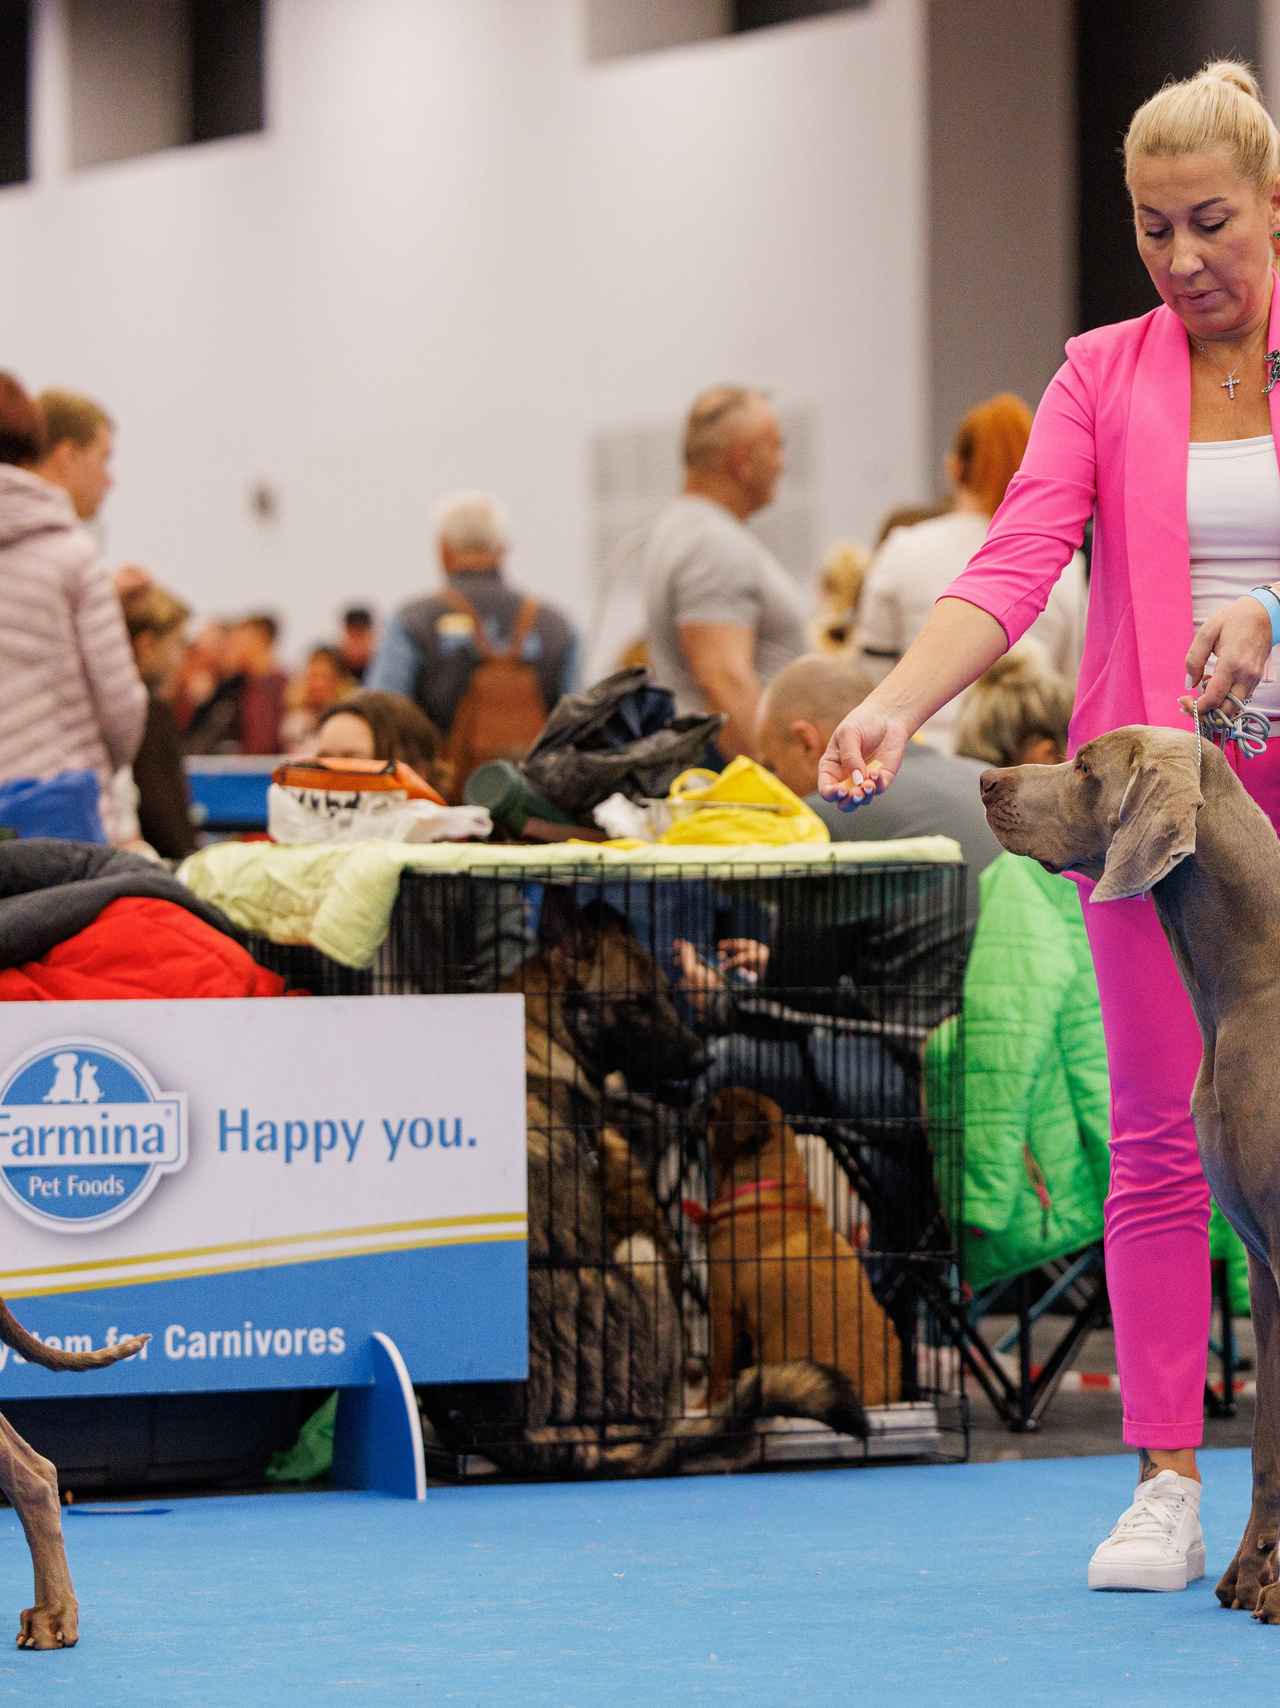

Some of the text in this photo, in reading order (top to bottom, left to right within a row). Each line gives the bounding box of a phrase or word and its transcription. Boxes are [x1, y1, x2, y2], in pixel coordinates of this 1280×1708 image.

[219, 1108, 477, 1163] Happy you.
[29, 1174, 125, 1198] Pet Foods
[164, 1321, 346, 1360] Carnivores
